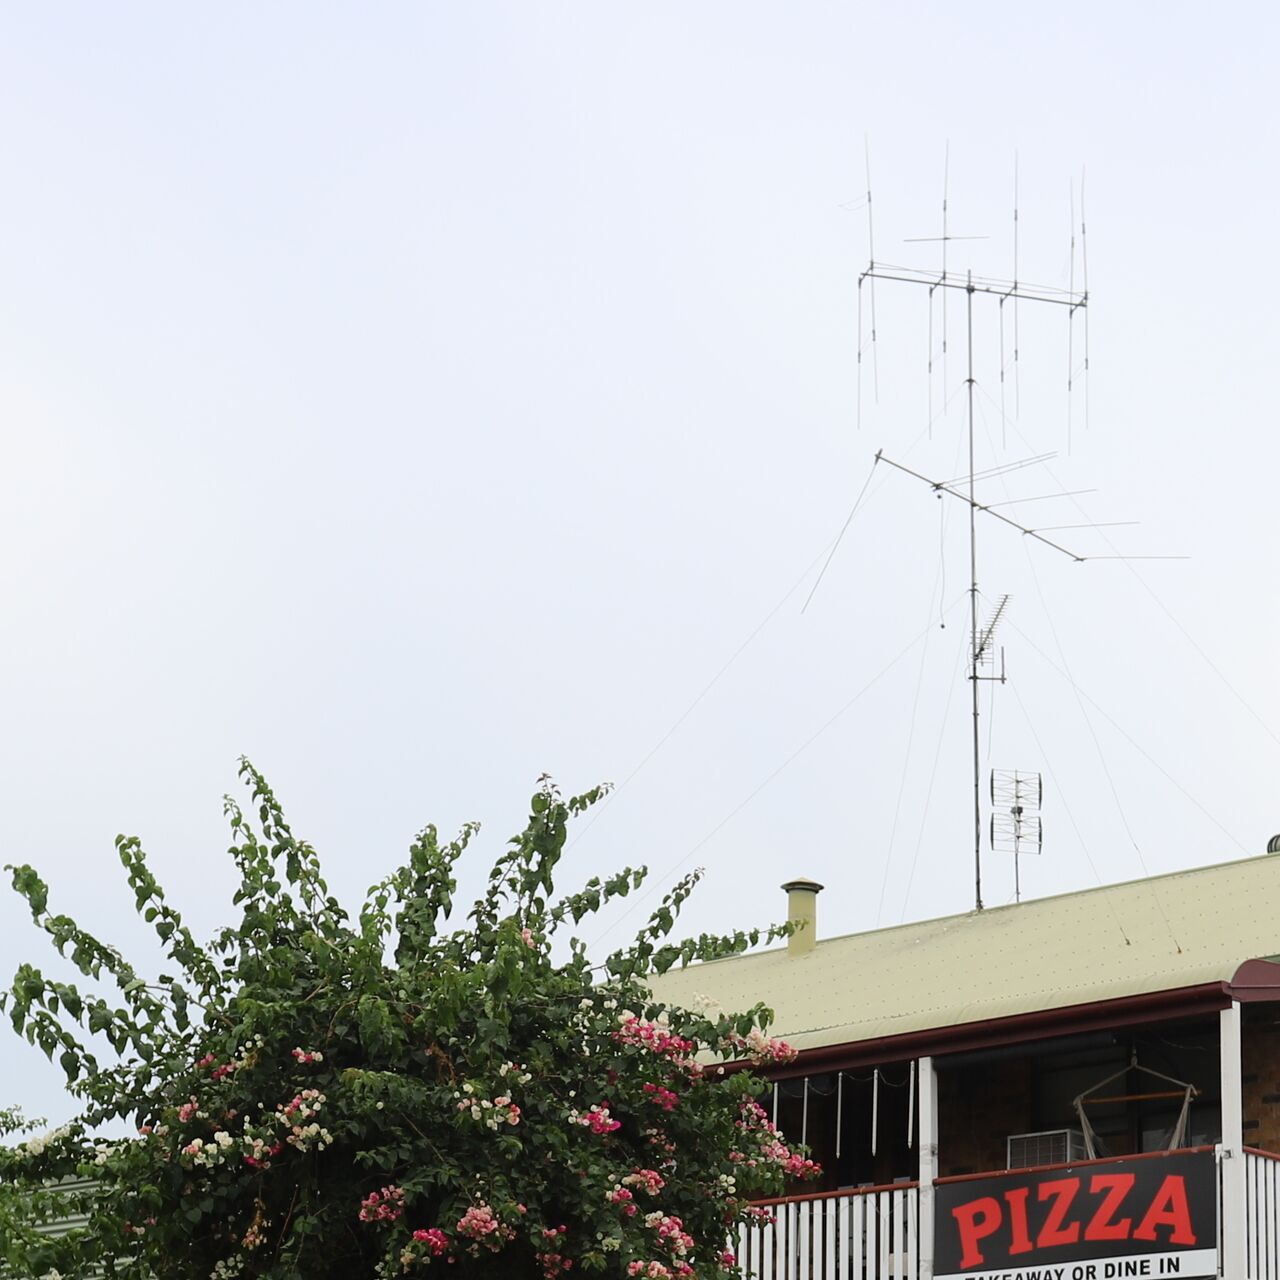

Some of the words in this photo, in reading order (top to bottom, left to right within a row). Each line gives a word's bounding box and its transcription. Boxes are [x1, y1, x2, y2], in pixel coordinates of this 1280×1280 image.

[952, 1173, 1197, 1270] PIZZA
[1072, 1266, 1097, 1280] OR
[1104, 1259, 1151, 1279] DINE
[1159, 1257, 1180, 1274] IN
